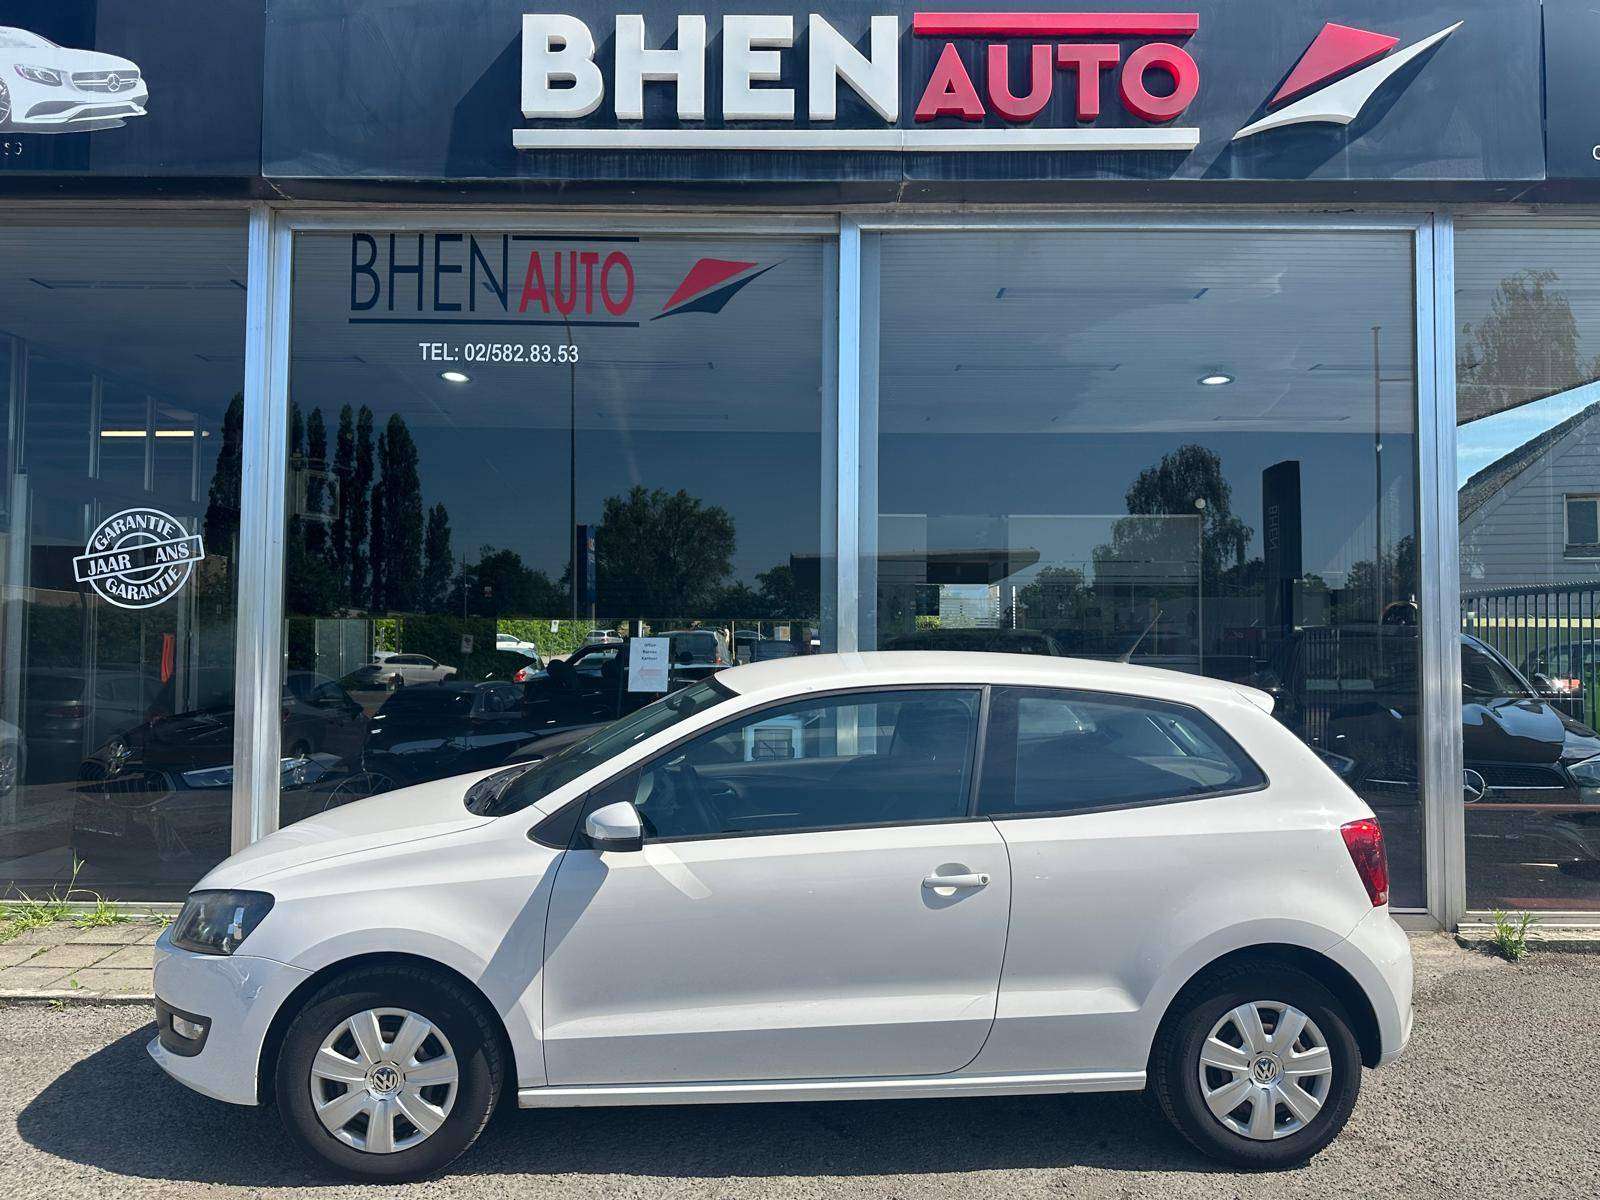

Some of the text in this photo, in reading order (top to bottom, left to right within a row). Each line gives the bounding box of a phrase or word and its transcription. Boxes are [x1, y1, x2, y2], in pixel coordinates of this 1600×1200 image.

[520, 14, 1200, 122] BHEN AUTO
[351, 233, 635, 316] BHEN AUTO
[419, 343, 580, 363] TEL: 02/582.83.53
[95, 514, 176, 550] GARANTIE
[88, 542, 190, 576] JAAR ANS
[105, 564, 182, 600] GARANTIE
